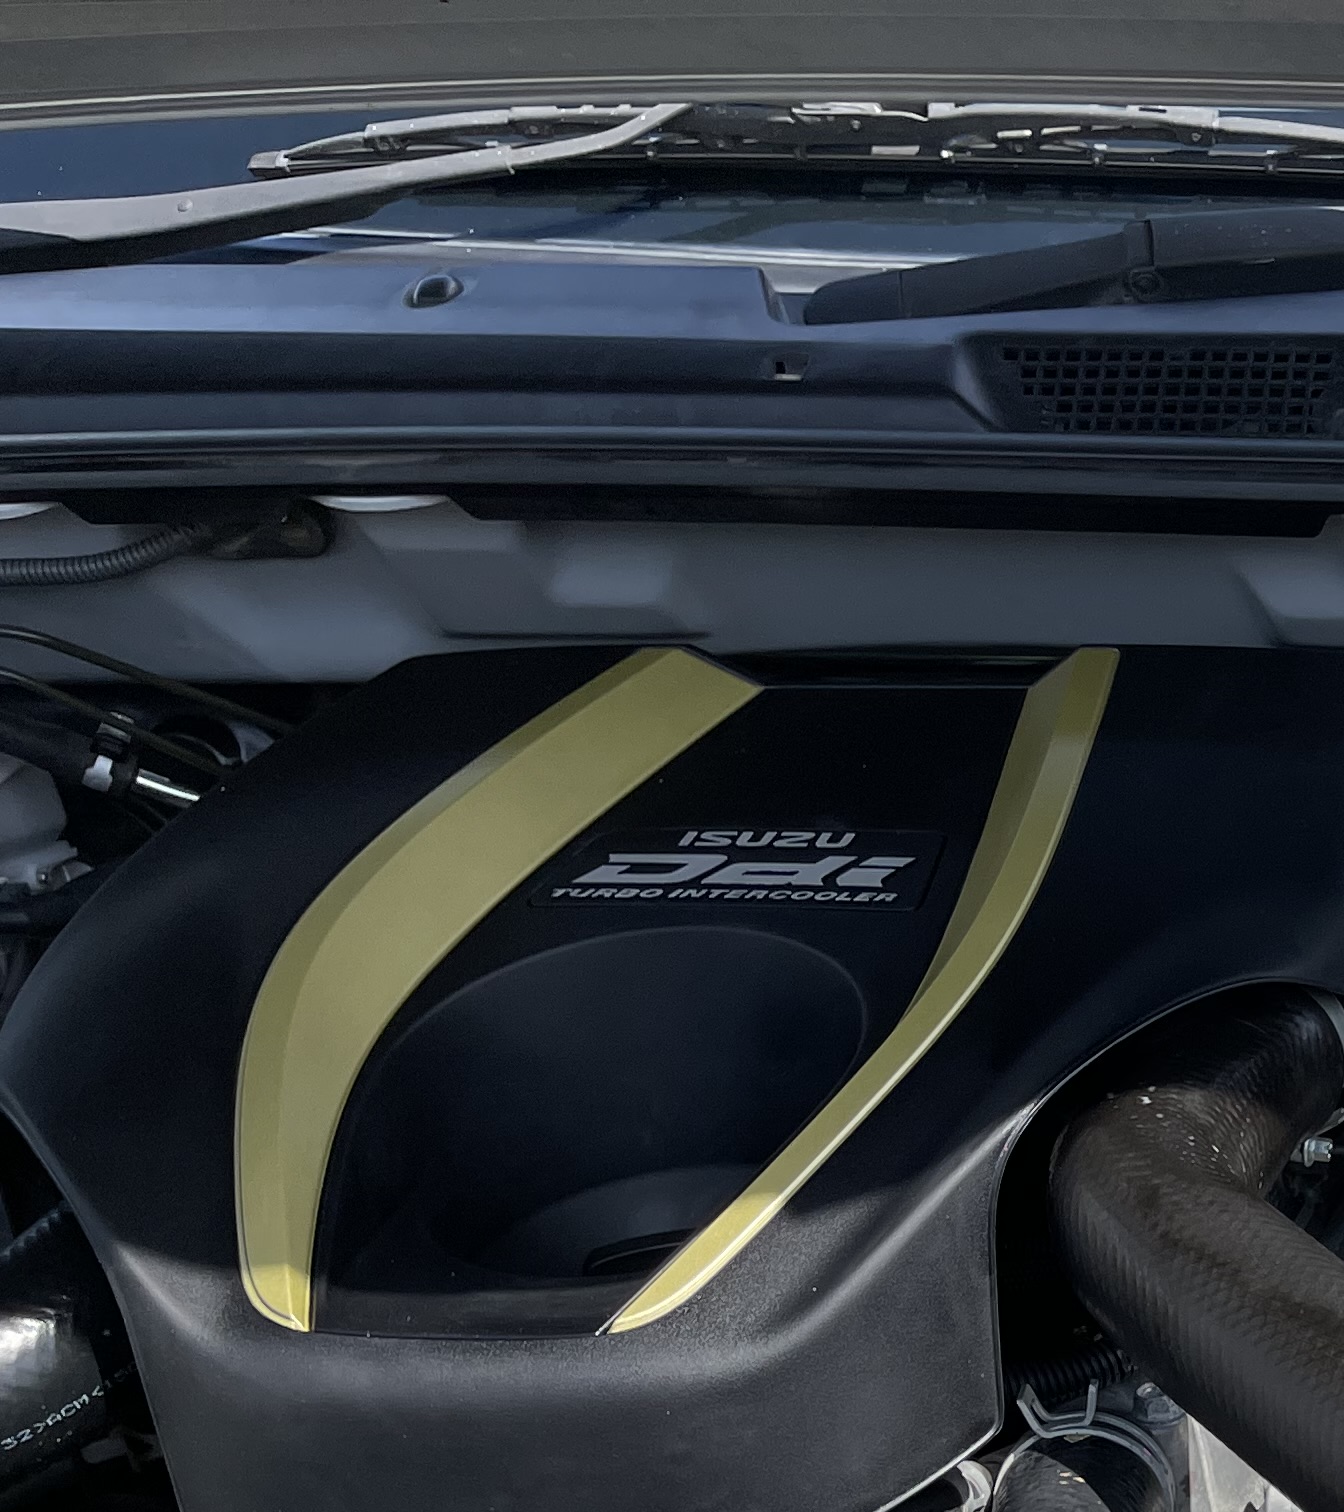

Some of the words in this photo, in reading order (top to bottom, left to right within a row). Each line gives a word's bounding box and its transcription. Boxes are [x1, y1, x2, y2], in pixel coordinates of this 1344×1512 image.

[677, 830, 857, 849] ISUZU
[551, 887, 664, 899] TURBO
[668, 888, 899, 903] INTERCOOLER
